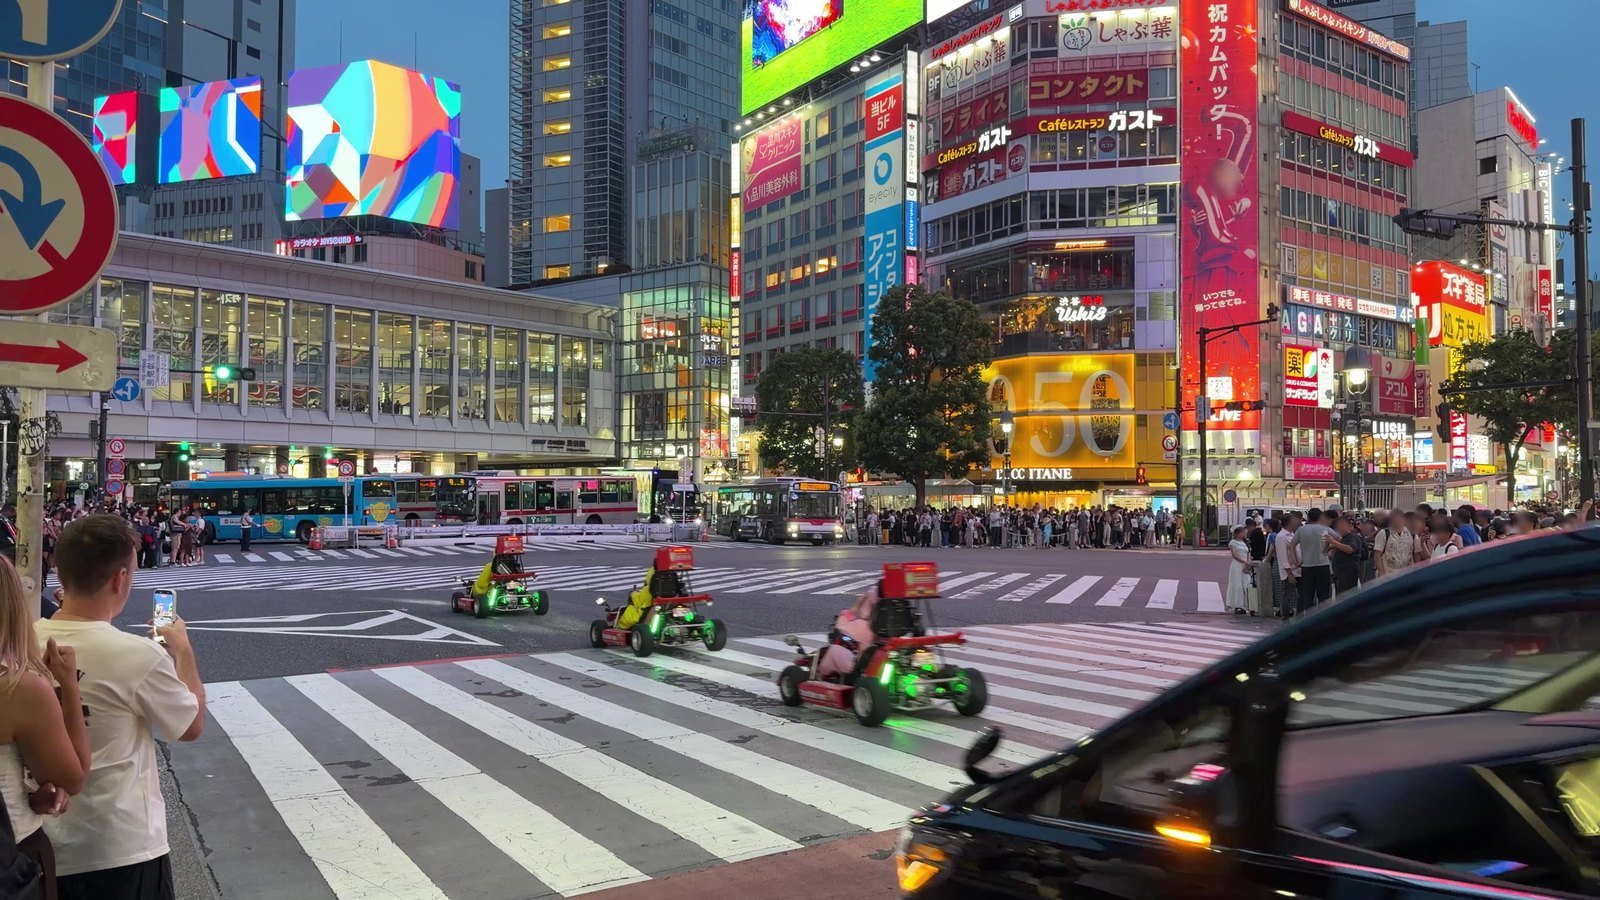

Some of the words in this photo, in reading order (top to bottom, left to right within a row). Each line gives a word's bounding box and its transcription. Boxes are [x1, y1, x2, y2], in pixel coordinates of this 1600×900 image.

[930, 14, 1003, 60] しゃぶしゃぶバイキング
[1099, 16, 1172, 42] しゃぶ葉
[964, 41, 1006, 77] しゃぶ葉
[928, 75, 940, 93] 9F
[1031, 73, 1144, 100] コンタクト
[871, 95, 896, 117] 当ビル
[943, 91, 1007, 135] プライス
[877, 113, 891, 131] 5F
[1108, 110, 1163, 132] ガスト
[768, 124, 799, 147] 品川スキン
[979, 126, 1012, 153] ガスト
[1354, 134, 1380, 158] ガスト
[768, 139, 795, 160] クリニック
[751, 170, 798, 202] 品川美容外科
[963, 158, 1002, 192] ガスト
[1539, 169, 1548, 188] BIC
[869, 186, 897, 203] eyecity
[927, 181, 939, 197] 7F
[294, 239, 318, 248] カラオケ
[320, 236, 351, 245] JOYSOUND
[886, 229, 897, 291] コンタ
[1203, 289, 1236, 301] いつでも
[1442, 272, 1485, 307] スギ薬局
[1055, 306, 1107, 321] Ushi8
[1195, 297, 1247, 312] 帰ってきてね。
[1400, 306, 1413, 323] 4F
[1282, 309, 1323, 335] AGA
[1288, 350, 1301, 374] 薬
[1286, 388, 1317, 400] サンドラッグ
[1385, 381, 1408, 397] アコム
[1030, 370, 1131, 457] 50
[1372, 421, 1406, 440] LUSH
[996, 468, 1072, 480] L'CCITANE
